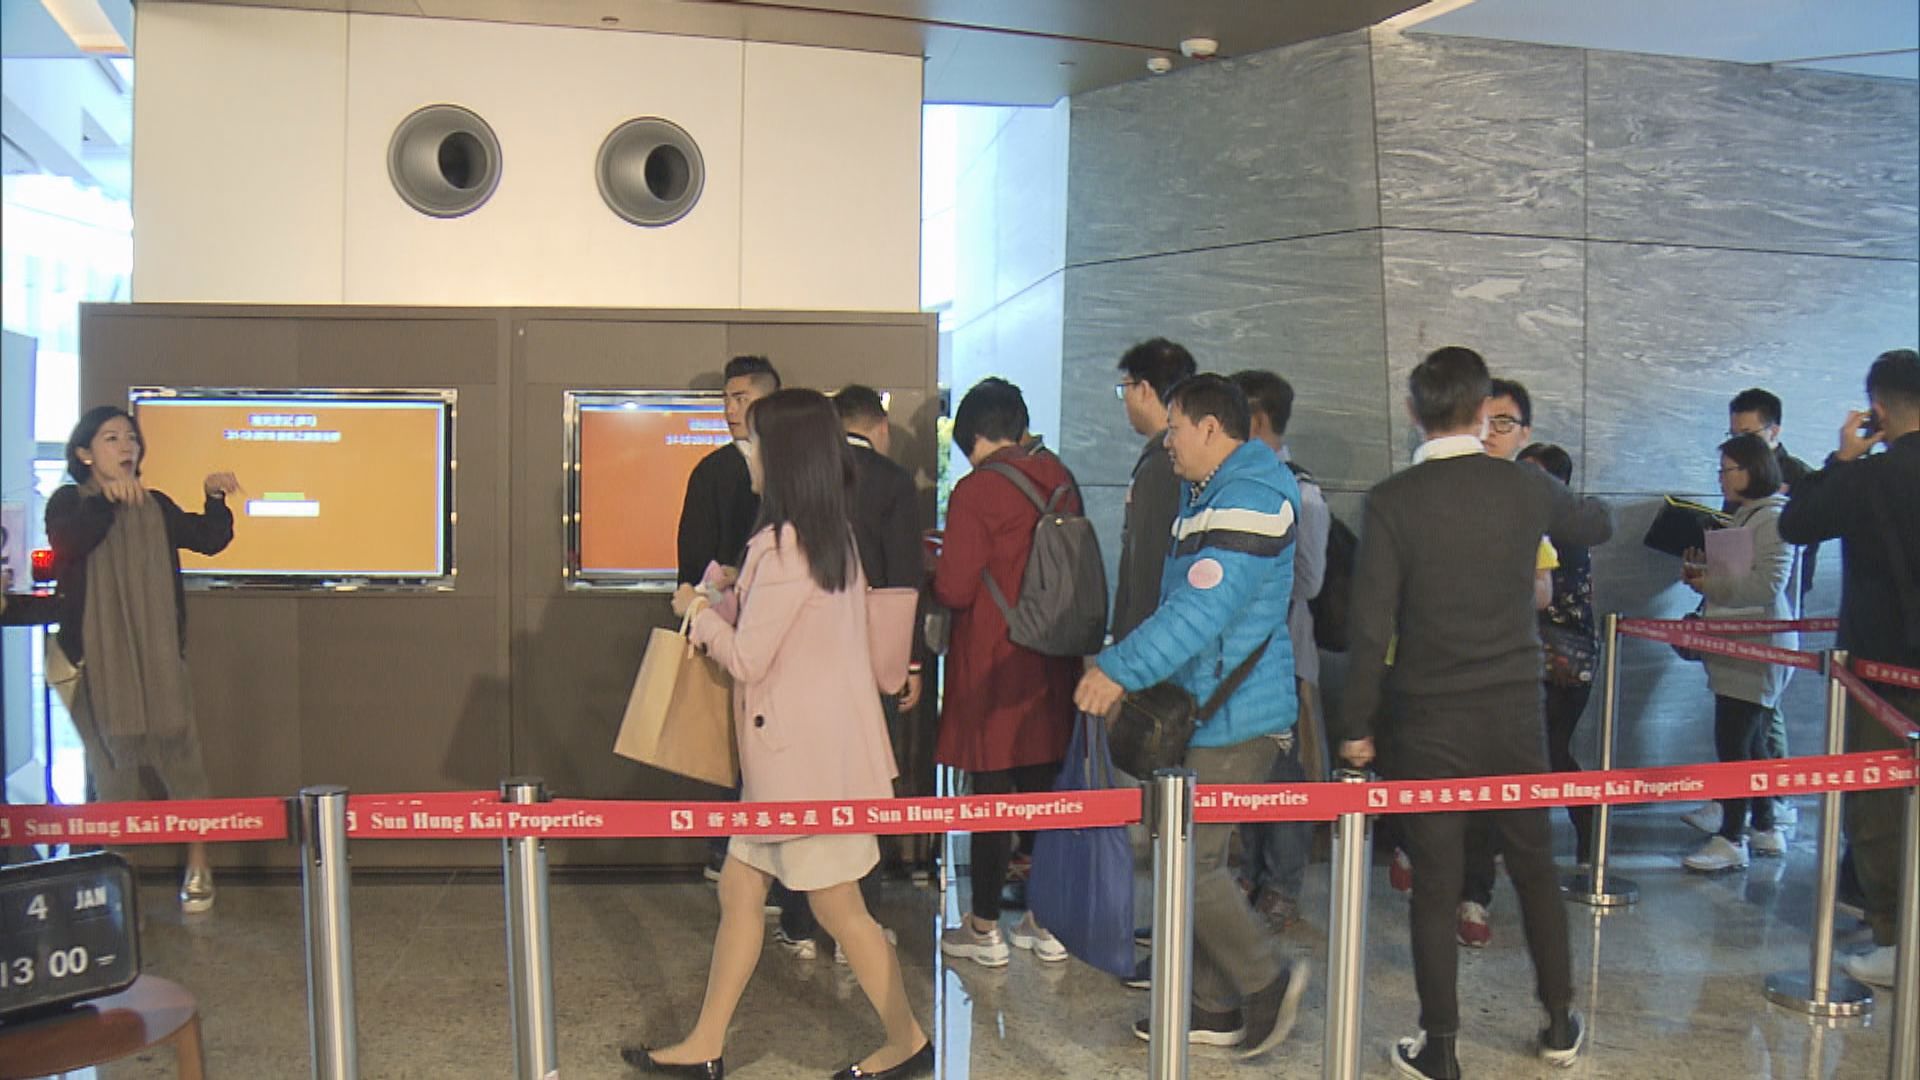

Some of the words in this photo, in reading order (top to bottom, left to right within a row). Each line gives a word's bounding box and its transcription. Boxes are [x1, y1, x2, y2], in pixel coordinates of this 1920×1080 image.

[1221, 790, 1309, 811] Properties
[1530, 784, 1559, 799] Sun
[1563, 783, 1601, 799] Hung
[1605, 780, 1630, 796] Kai
[1633, 777, 1704, 797] Properties
[371, 812, 407, 829] Sun
[413, 812, 464, 832] Hung
[470, 812, 502, 829] Kai
[508, 810, 604, 831] Properties
[867, 806, 901, 823] Sun
[906, 805, 954, 823] Hung
[960, 802, 990, 819] Kai
[995, 798, 1083, 820] Properties
[25, 818, 63, 836] Sun
[68, 817, 121, 837] Hung
[126, 816, 159, 833] Kai
[165, 812, 263, 834] Properties
[27, 894, 48, 920] 4
[74, 886, 107, 910] JAN
[48, 946, 88, 978] 00
